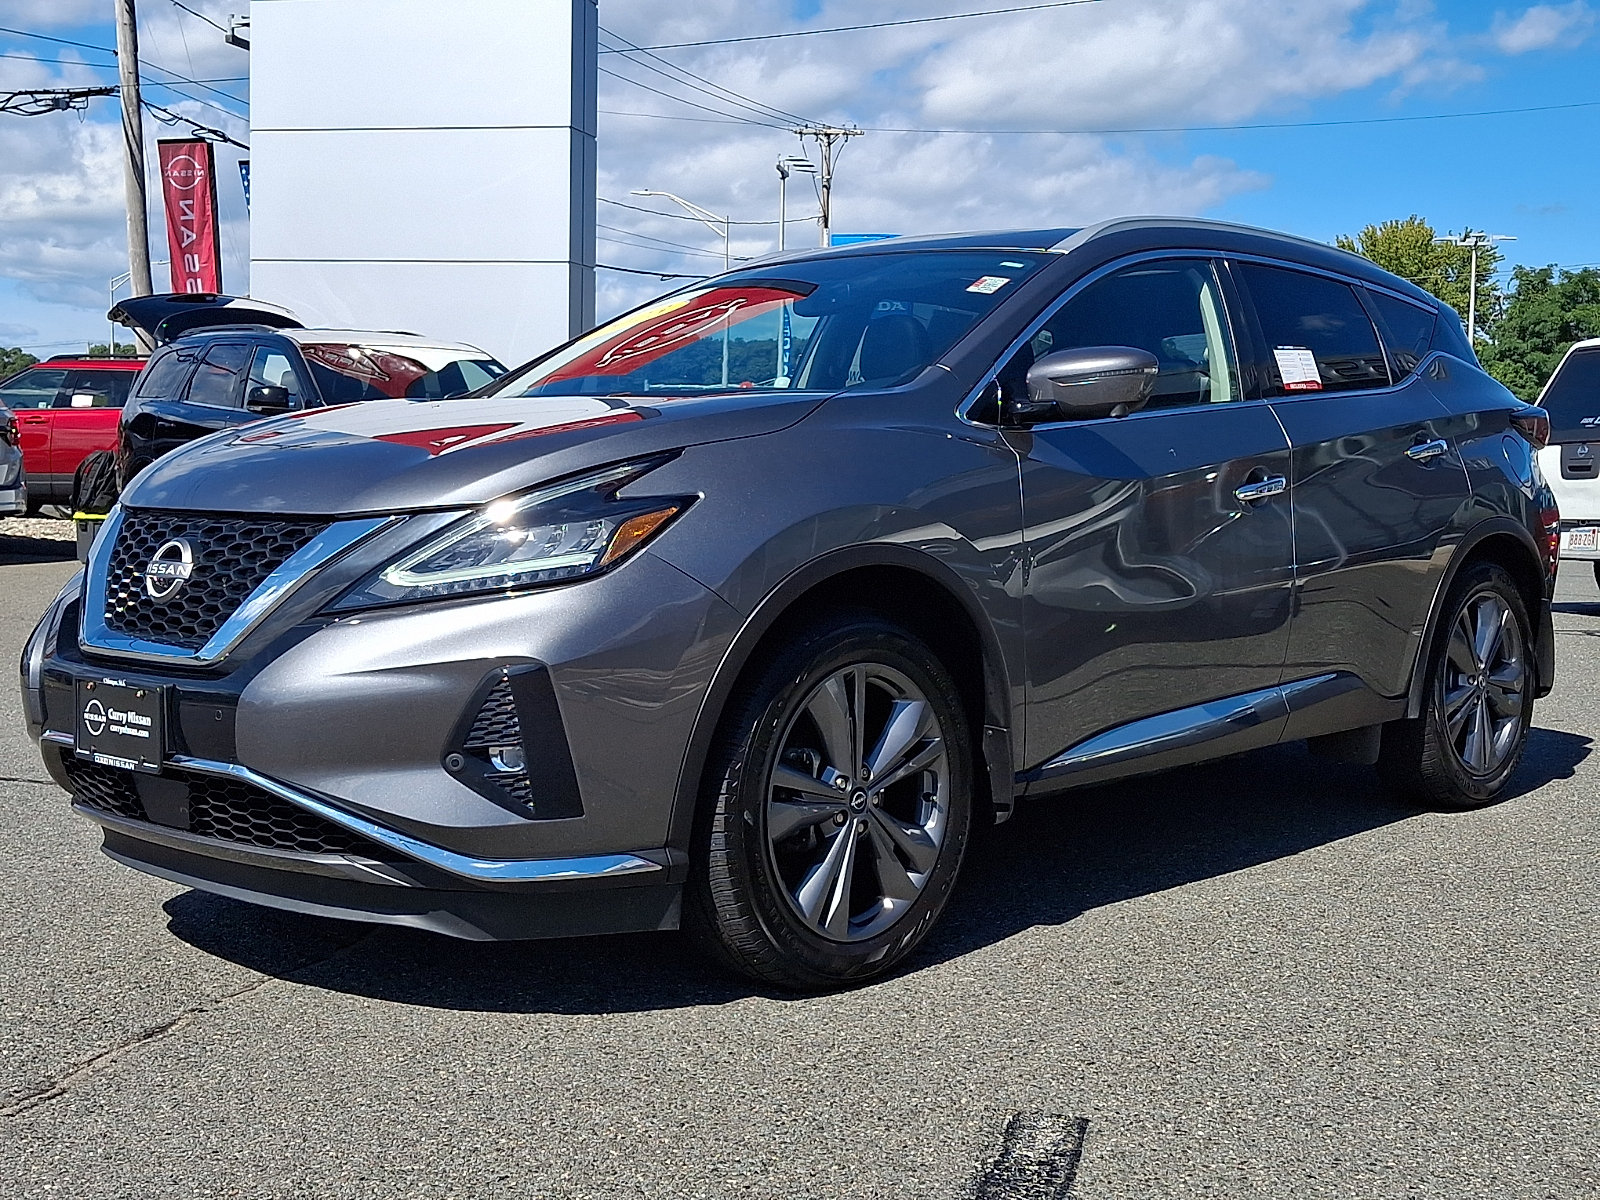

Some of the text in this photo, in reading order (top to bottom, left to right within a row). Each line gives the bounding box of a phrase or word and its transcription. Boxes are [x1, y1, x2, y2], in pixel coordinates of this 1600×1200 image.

[83, 712, 107, 723] NISSAN
[107, 708, 152, 727] Curry Nissan
